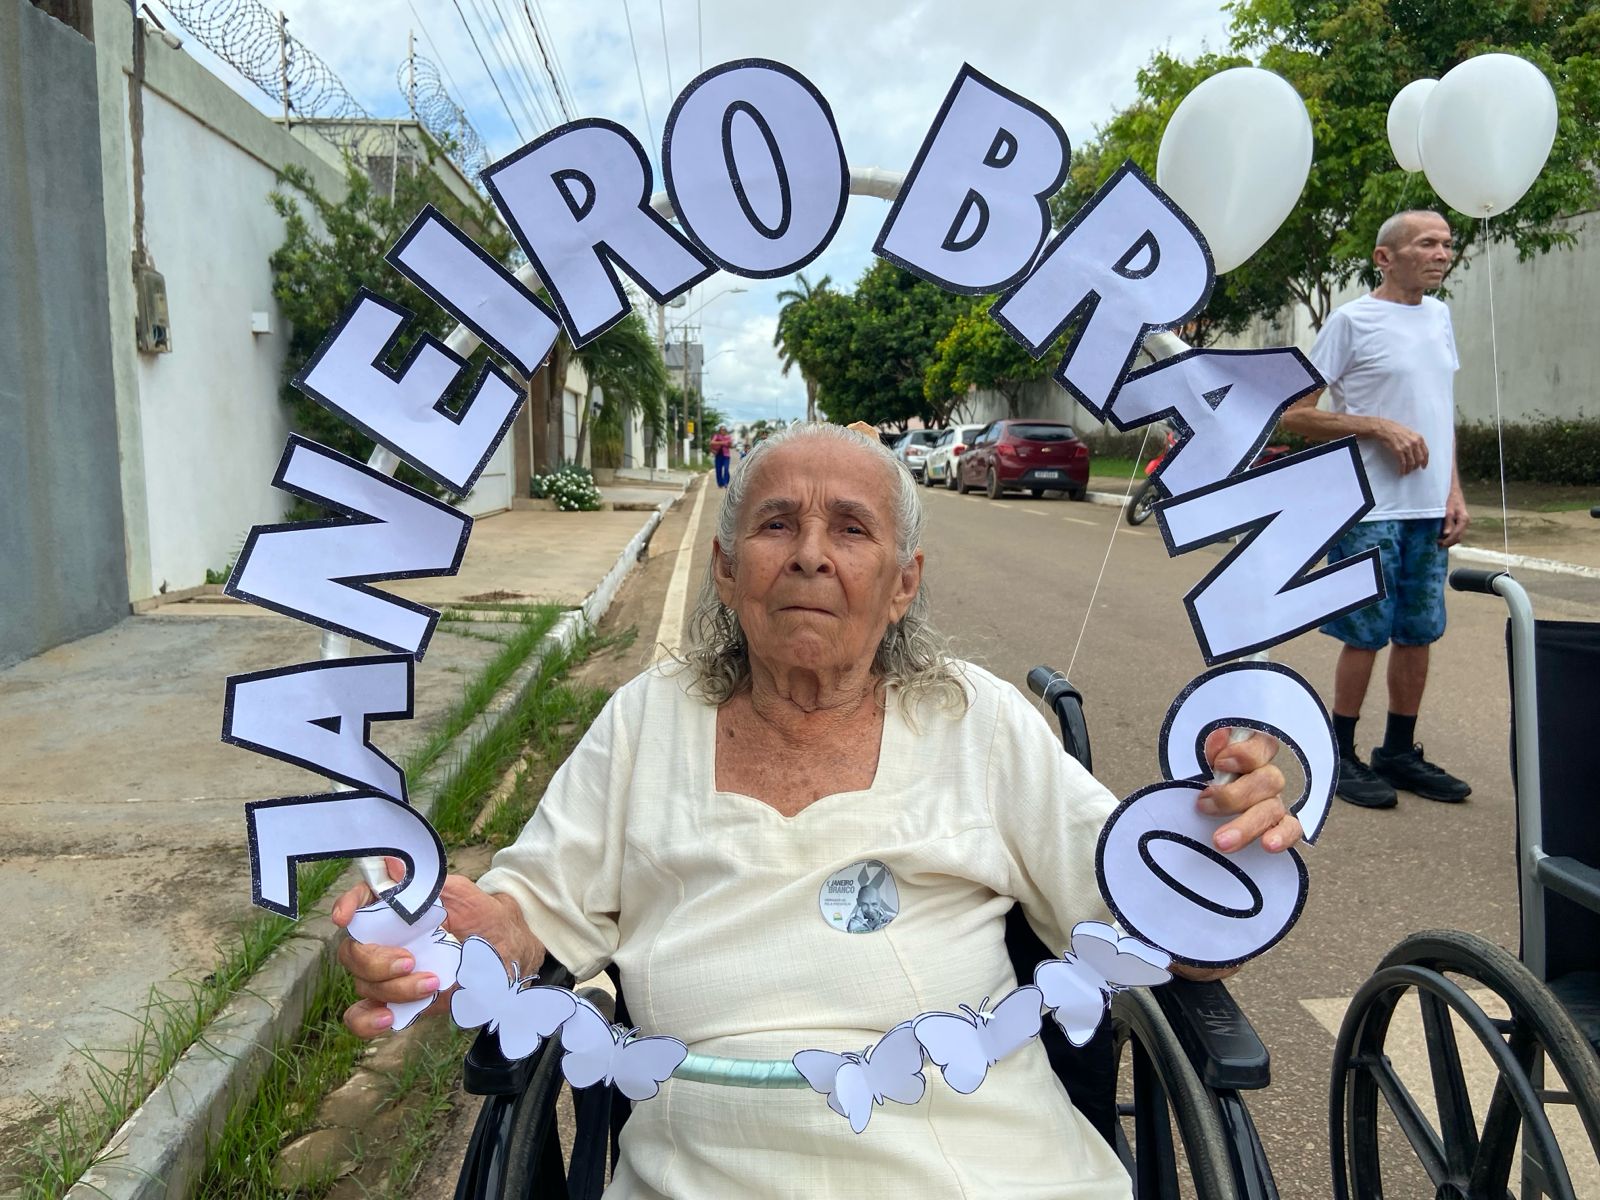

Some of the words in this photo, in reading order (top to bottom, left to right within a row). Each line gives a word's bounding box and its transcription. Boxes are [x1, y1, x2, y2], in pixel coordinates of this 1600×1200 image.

[222, 57, 849, 924] JANEIRO
[873, 62, 1386, 967] BRANCO
[831, 879, 854, 887] JANEIRO
[828, 886, 855, 894] BRANCO
